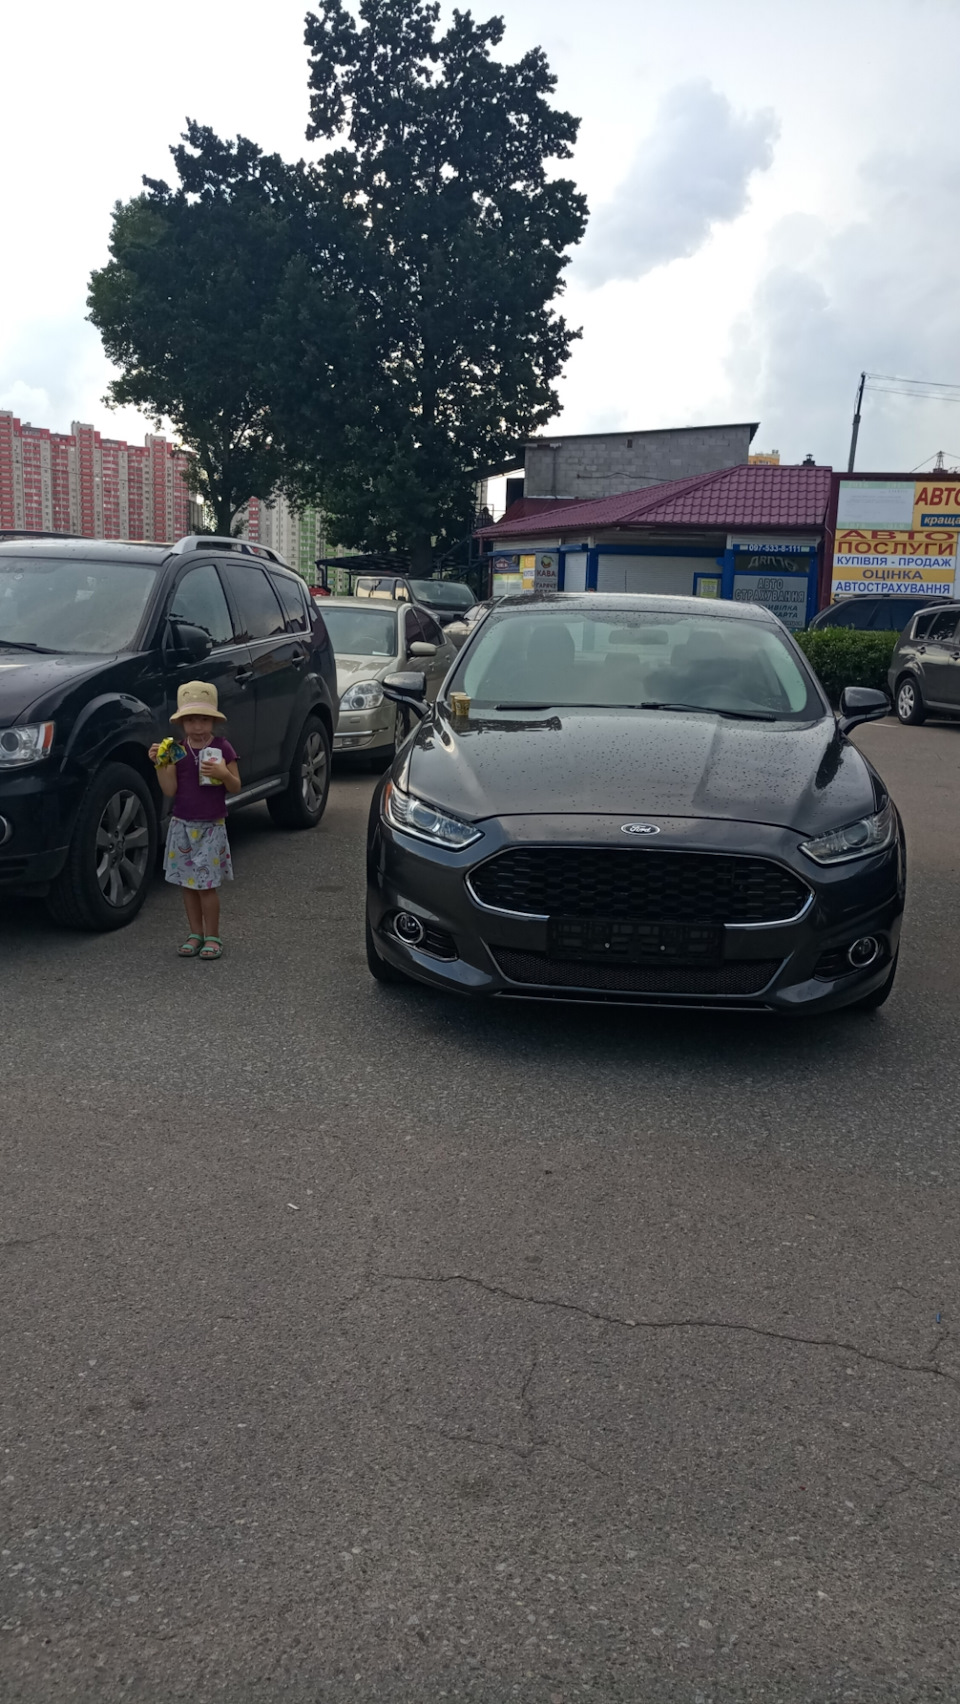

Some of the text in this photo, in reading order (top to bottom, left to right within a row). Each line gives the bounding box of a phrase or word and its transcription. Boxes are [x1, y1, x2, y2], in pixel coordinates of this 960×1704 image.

[840, 530, 954, 541] АВТО
[837, 541, 954, 555] ПОСЛУГИ
[837, 556, 887, 566] КУПІВЛЯ
[898, 557, 952, 567] ПРОДАЖ
[862, 569, 923, 580] ОЦІНКА
[757, 578, 783, 590] АВТО
[835, 581, 950, 594] АВТОСТРАХУВАННЯ
[734, 589, 804, 602] СТРАХУВАННЯ
